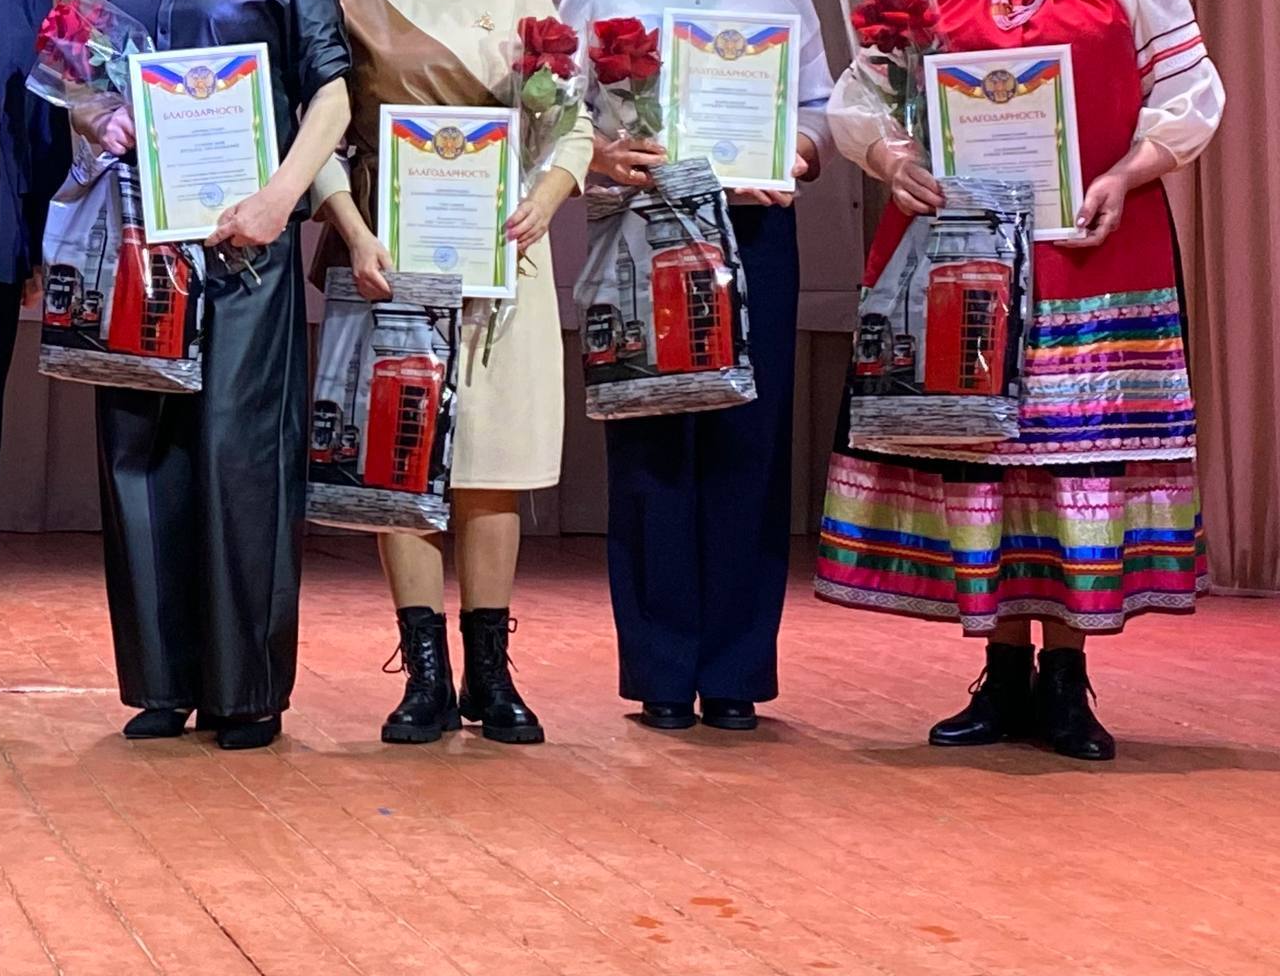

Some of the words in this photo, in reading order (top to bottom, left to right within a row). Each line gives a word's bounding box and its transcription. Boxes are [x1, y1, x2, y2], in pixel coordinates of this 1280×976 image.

[163, 105, 244, 121] БЛАГОДАРНОСТЬ
[959, 110, 1047, 124] БЛАГОДАРНОСТЬ
[407, 167, 491, 179] БЛАГОДАРНОСТЬ
